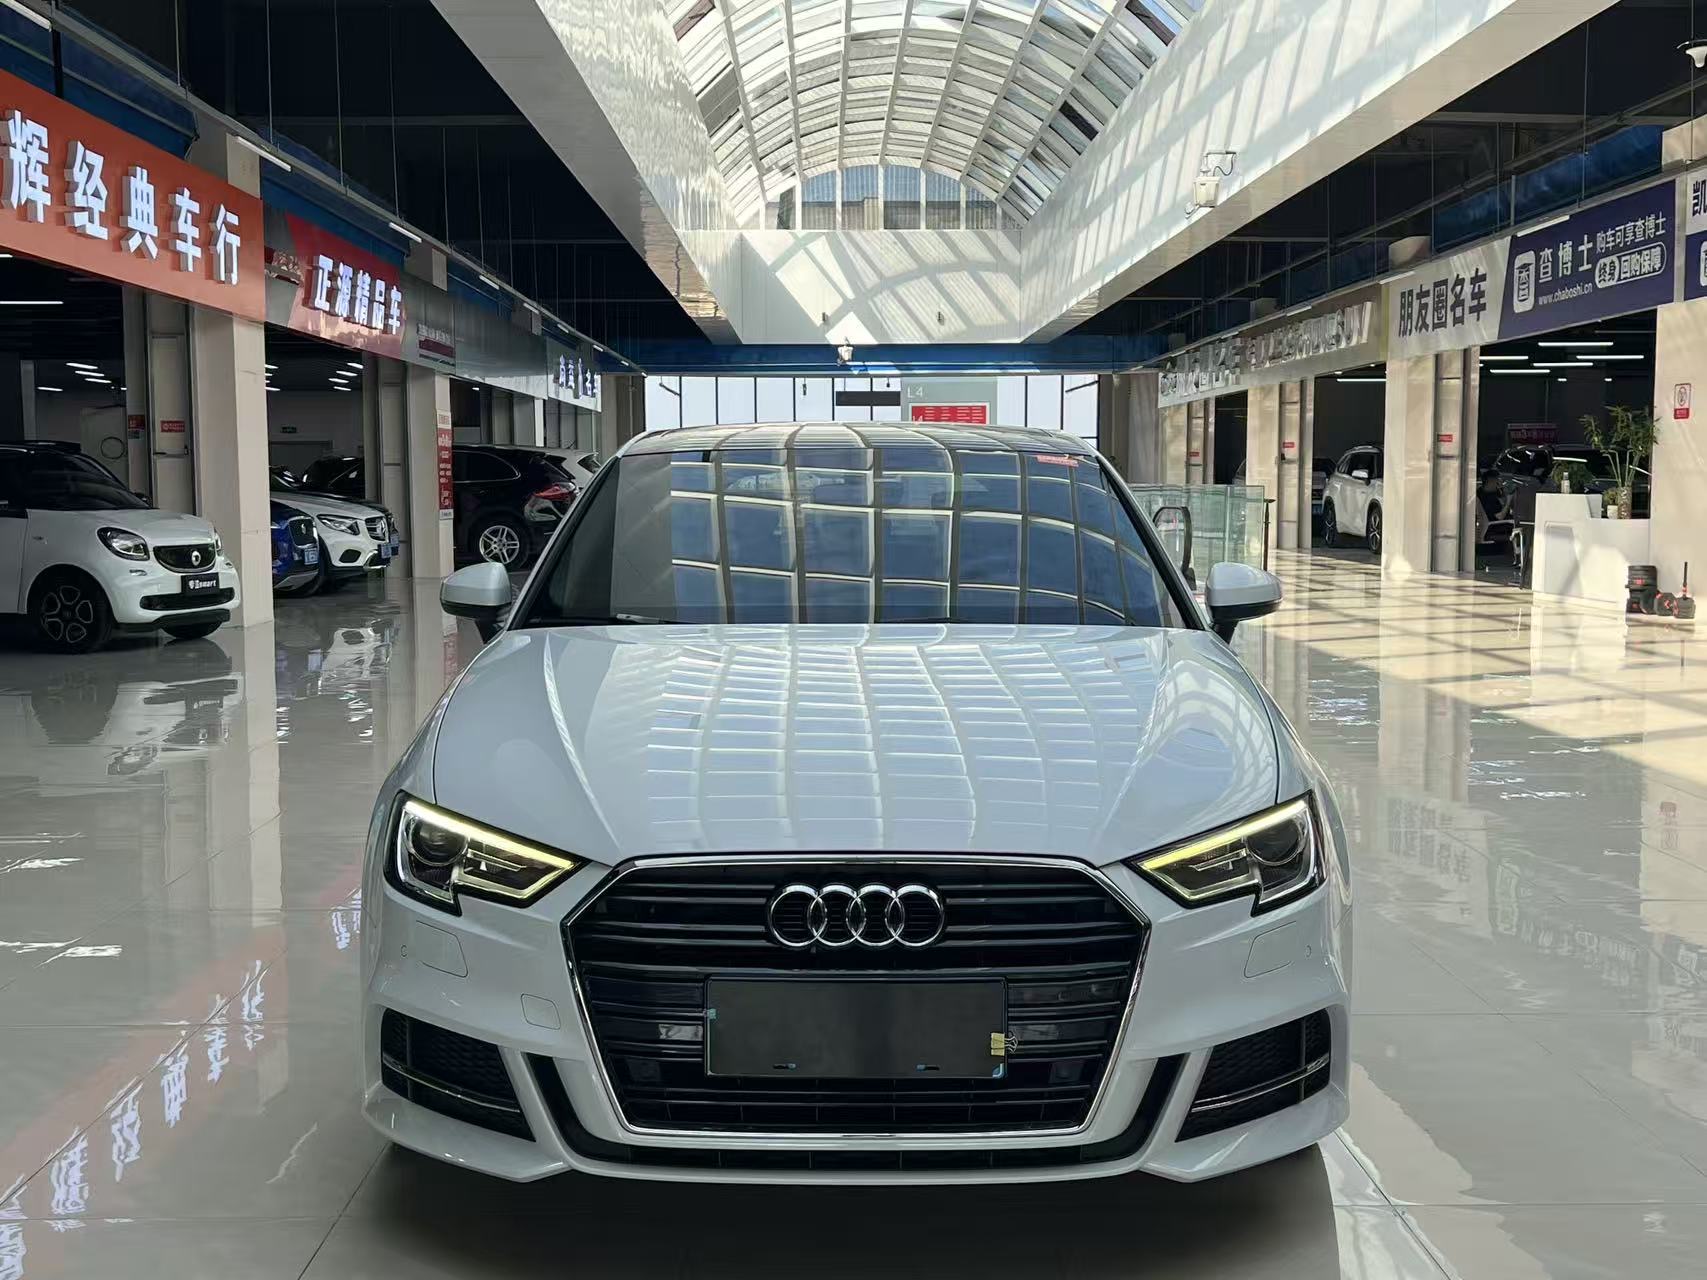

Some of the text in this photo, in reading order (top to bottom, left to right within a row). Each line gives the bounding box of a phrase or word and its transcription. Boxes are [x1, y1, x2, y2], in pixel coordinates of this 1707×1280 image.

[6, 109, 241, 285] 辉经典车行
[1596, 211, 1667, 254] 购车可享查博士
[1538, 234, 1593, 284] 查博士
[1398, 267, 1487, 338] 朋友圈名车
[1538, 282, 1593, 306] www.chaboshi.cn
[907, 386, 924, 399] L4
